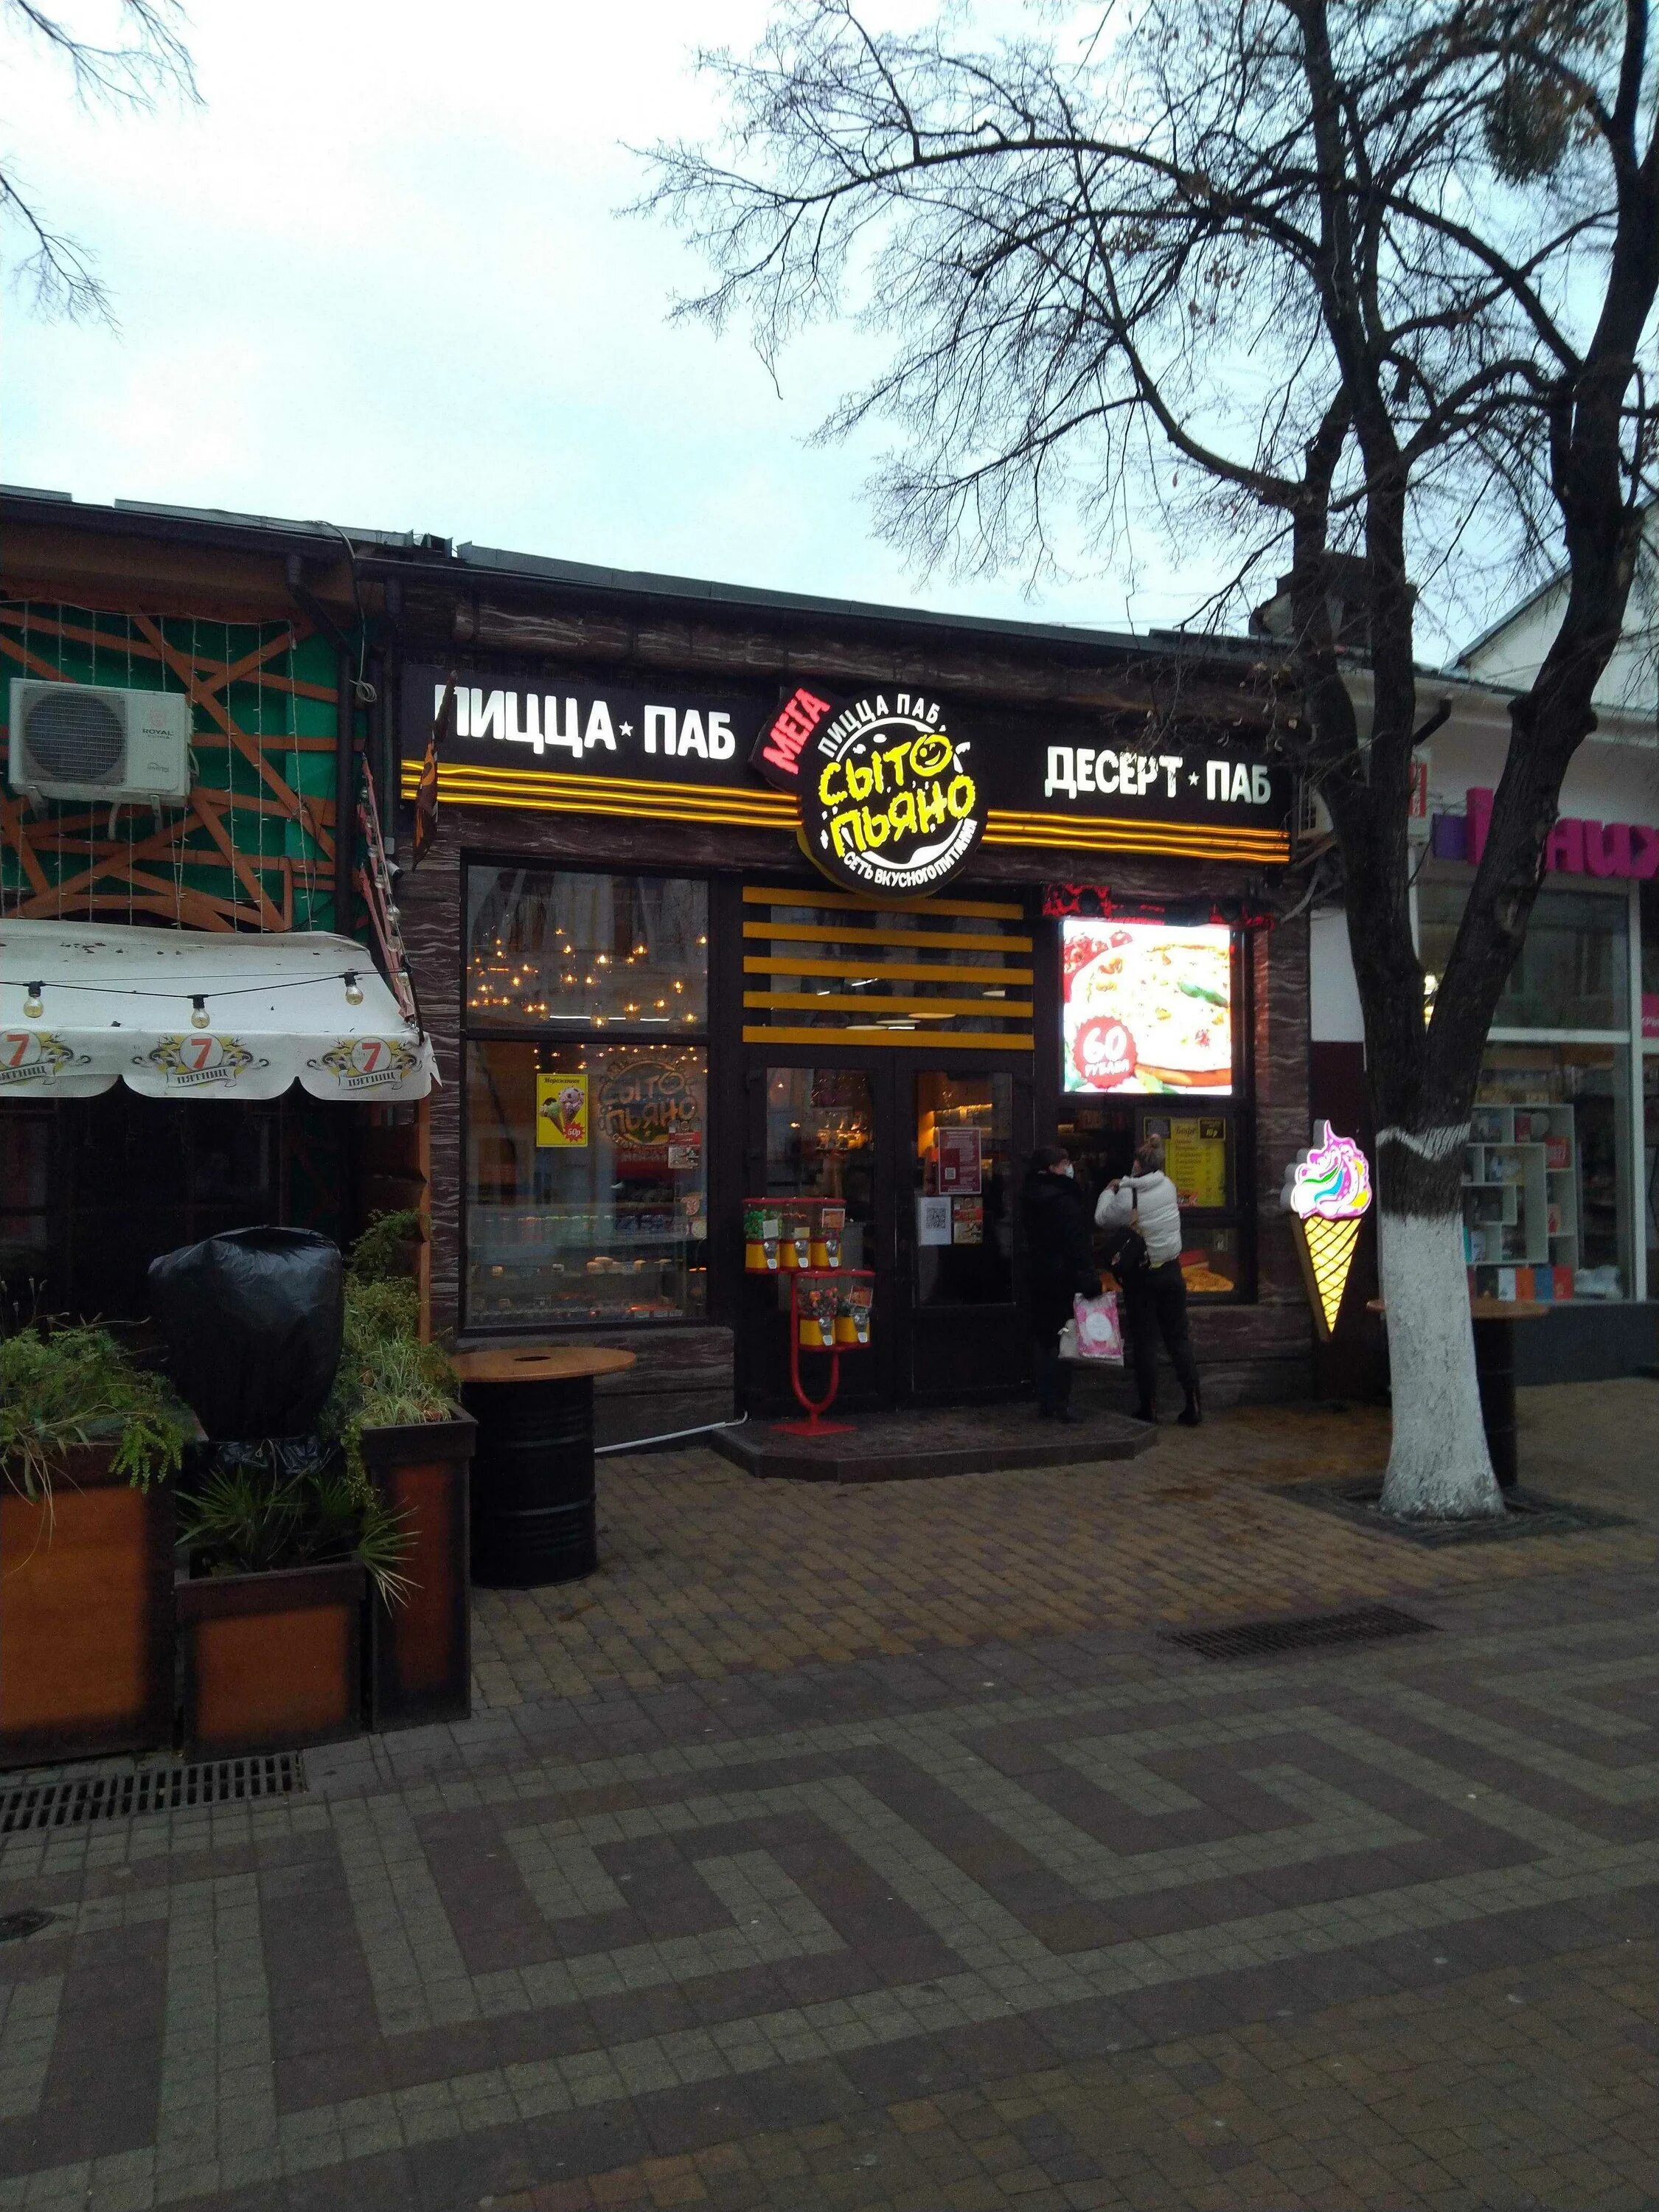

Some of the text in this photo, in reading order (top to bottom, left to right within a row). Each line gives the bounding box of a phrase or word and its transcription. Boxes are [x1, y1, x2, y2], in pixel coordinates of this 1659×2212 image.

[434, 684, 735, 759] ПИЦЦА ПАБ
[763, 688, 831, 774] МЕГА
[818, 693, 940, 757] ПИЦЦА ПАБ
[818, 734, 953, 805] СЫТО
[1044, 746, 1271, 805] ДЕСЕРТ ПАБ
[830, 774, 975, 858] ПЬЯНО
[844, 851, 874, 880] СЕТЬ
[874, 864, 937, 888] ВКУСНОГО
[7, 1034, 29, 1067] 7
[191, 1038, 212, 1069] 7
[361, 1042, 382, 1073] 7
[1082, 1024, 1127, 1063] 60
[0, 1065, 47, 1080] ЯТНИЦ
[567, 1128, 581, 1137] 50р
